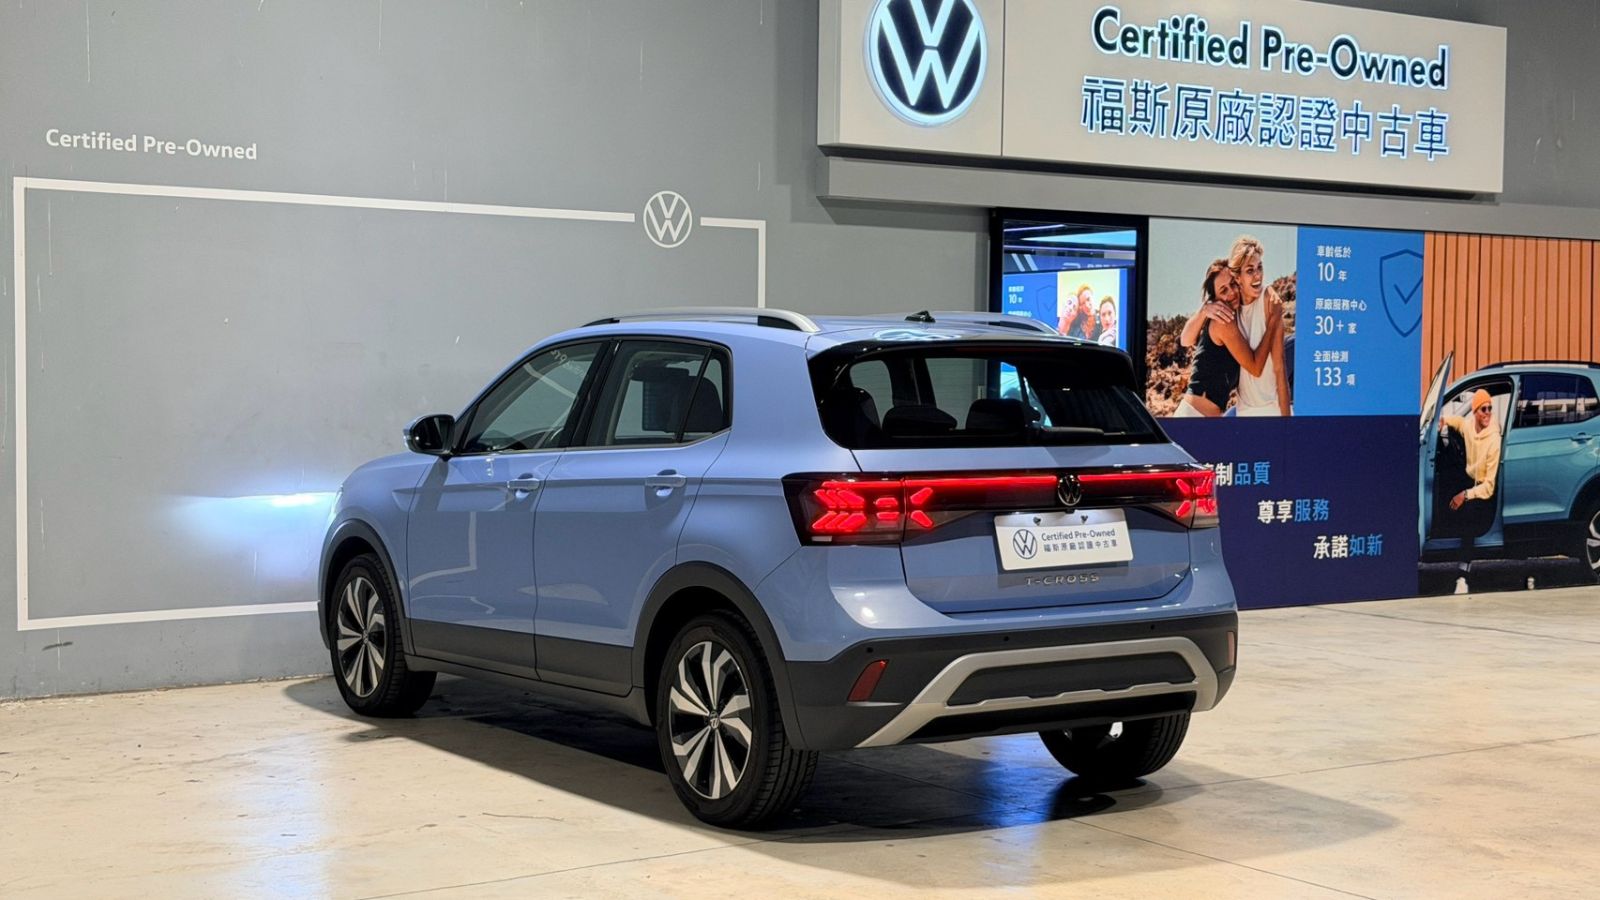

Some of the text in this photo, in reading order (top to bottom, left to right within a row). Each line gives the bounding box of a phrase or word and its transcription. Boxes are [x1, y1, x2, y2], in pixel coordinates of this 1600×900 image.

[1093, 5, 1450, 89] Certified Pre-Owned
[1081, 77, 1449, 160] 福斯原廠認證中古車
[46, 129, 257, 160] Certified Pre-Owned
[1316, 245, 1352, 258] 車齡低於
[1317, 262, 1348, 282] 10 年
[1315, 297, 1368, 312] 原廠服務中心
[1314, 367, 1342, 387] 133
[1203, 461, 1271, 486] 制品質
[1257, 498, 1330, 524] 尊享服務
[1041, 529, 1116, 541] Certified Pre-Owned
[1313, 533, 1383, 560] 承諾如新
[1025, 572, 1100, 587] T-CROSS
